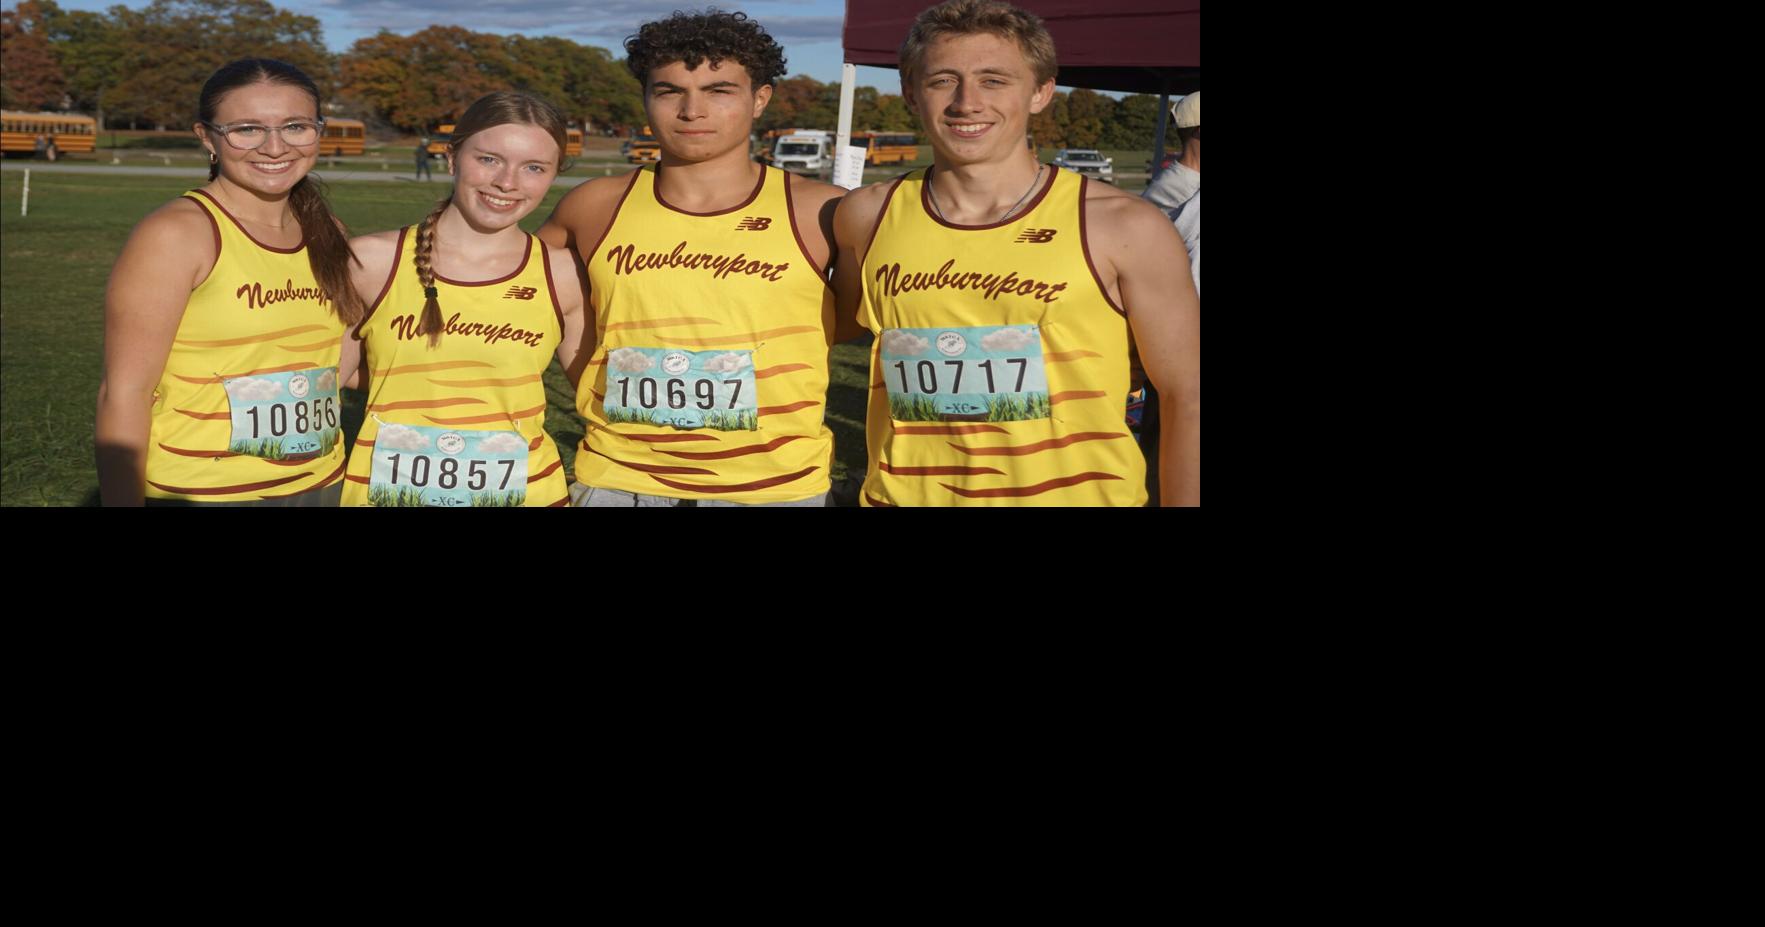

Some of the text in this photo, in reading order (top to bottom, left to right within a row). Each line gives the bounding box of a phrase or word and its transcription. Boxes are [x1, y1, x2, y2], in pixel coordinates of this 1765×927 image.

[735, 216, 772, 231] NB
[1014, 228, 1057, 243] NB
[607, 241, 789, 282] Newburyport
[236, 278, 333, 309] Newbury
[502, 285, 537, 300] NB
[876, 259, 1068, 303] Newburyport
[390, 312, 544, 347] Nburyport
[617, 377, 742, 410] 10697
[894, 358, 1027, 394] 10717
[246, 397, 336, 438] 10856
[387, 453, 515, 491] 10857
